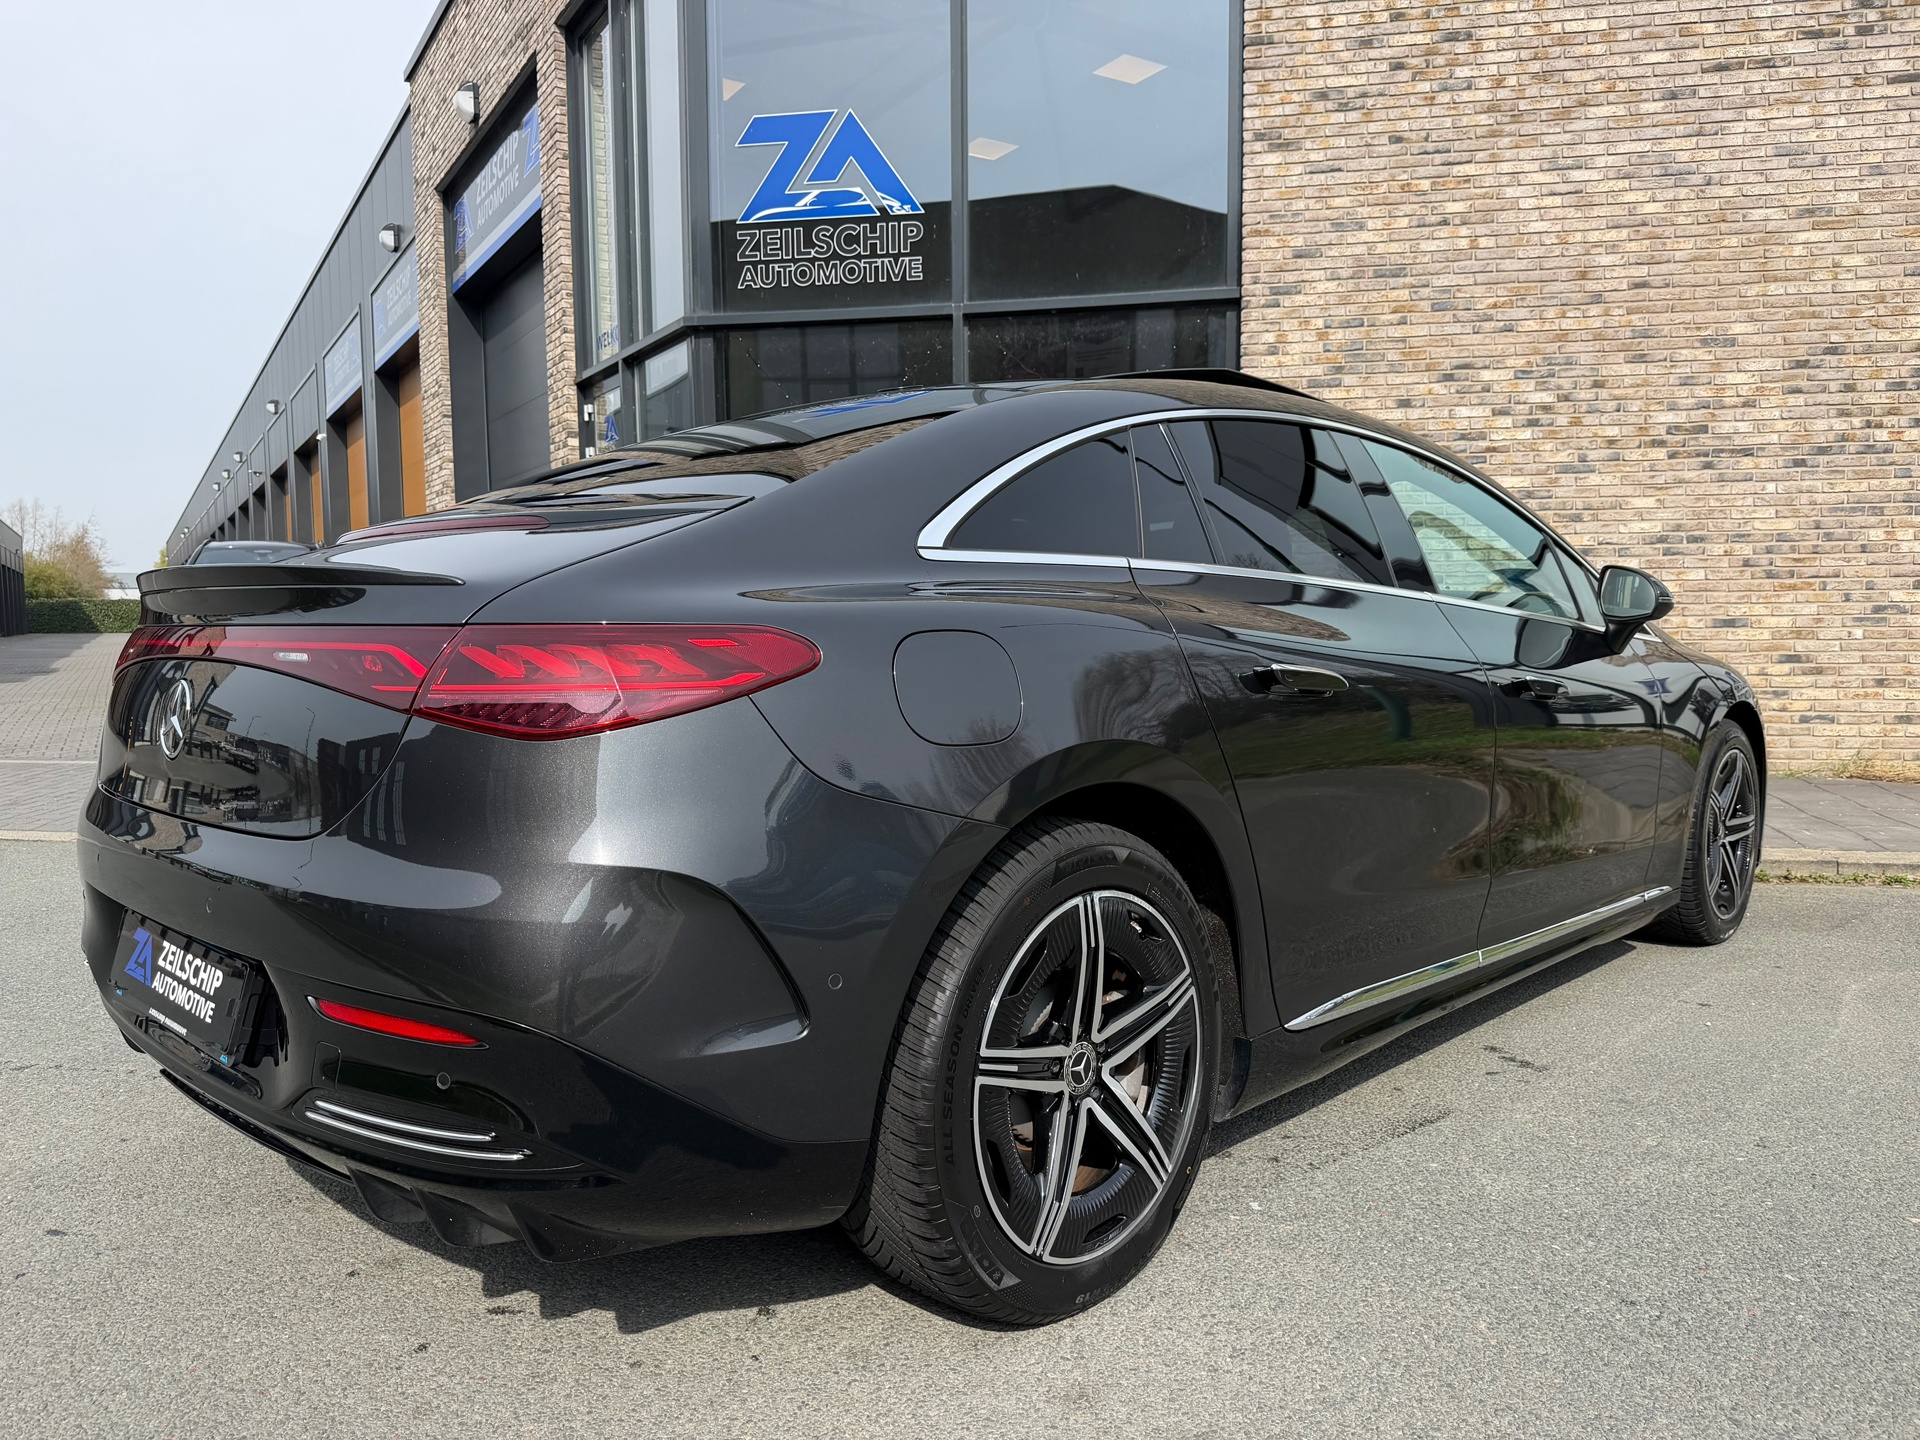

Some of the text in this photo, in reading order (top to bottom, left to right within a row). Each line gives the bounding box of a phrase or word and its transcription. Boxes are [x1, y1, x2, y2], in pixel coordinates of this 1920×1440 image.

[475, 129, 519, 205] ZEILSCHIP
[735, 108, 925, 224] ZA
[476, 164, 519, 229] AUTOMOTIVE
[736, 221, 924, 261] ZEILSCHIP
[737, 256, 923, 289] AUTOMOTIVE
[124, 927, 153, 987] ZA
[157, 940, 223, 996] ZEILSCHIP
[151, 971, 216, 1024] AUTOMOTIVE
[942, 966, 985, 1168] ALL SEASON DRIVER
